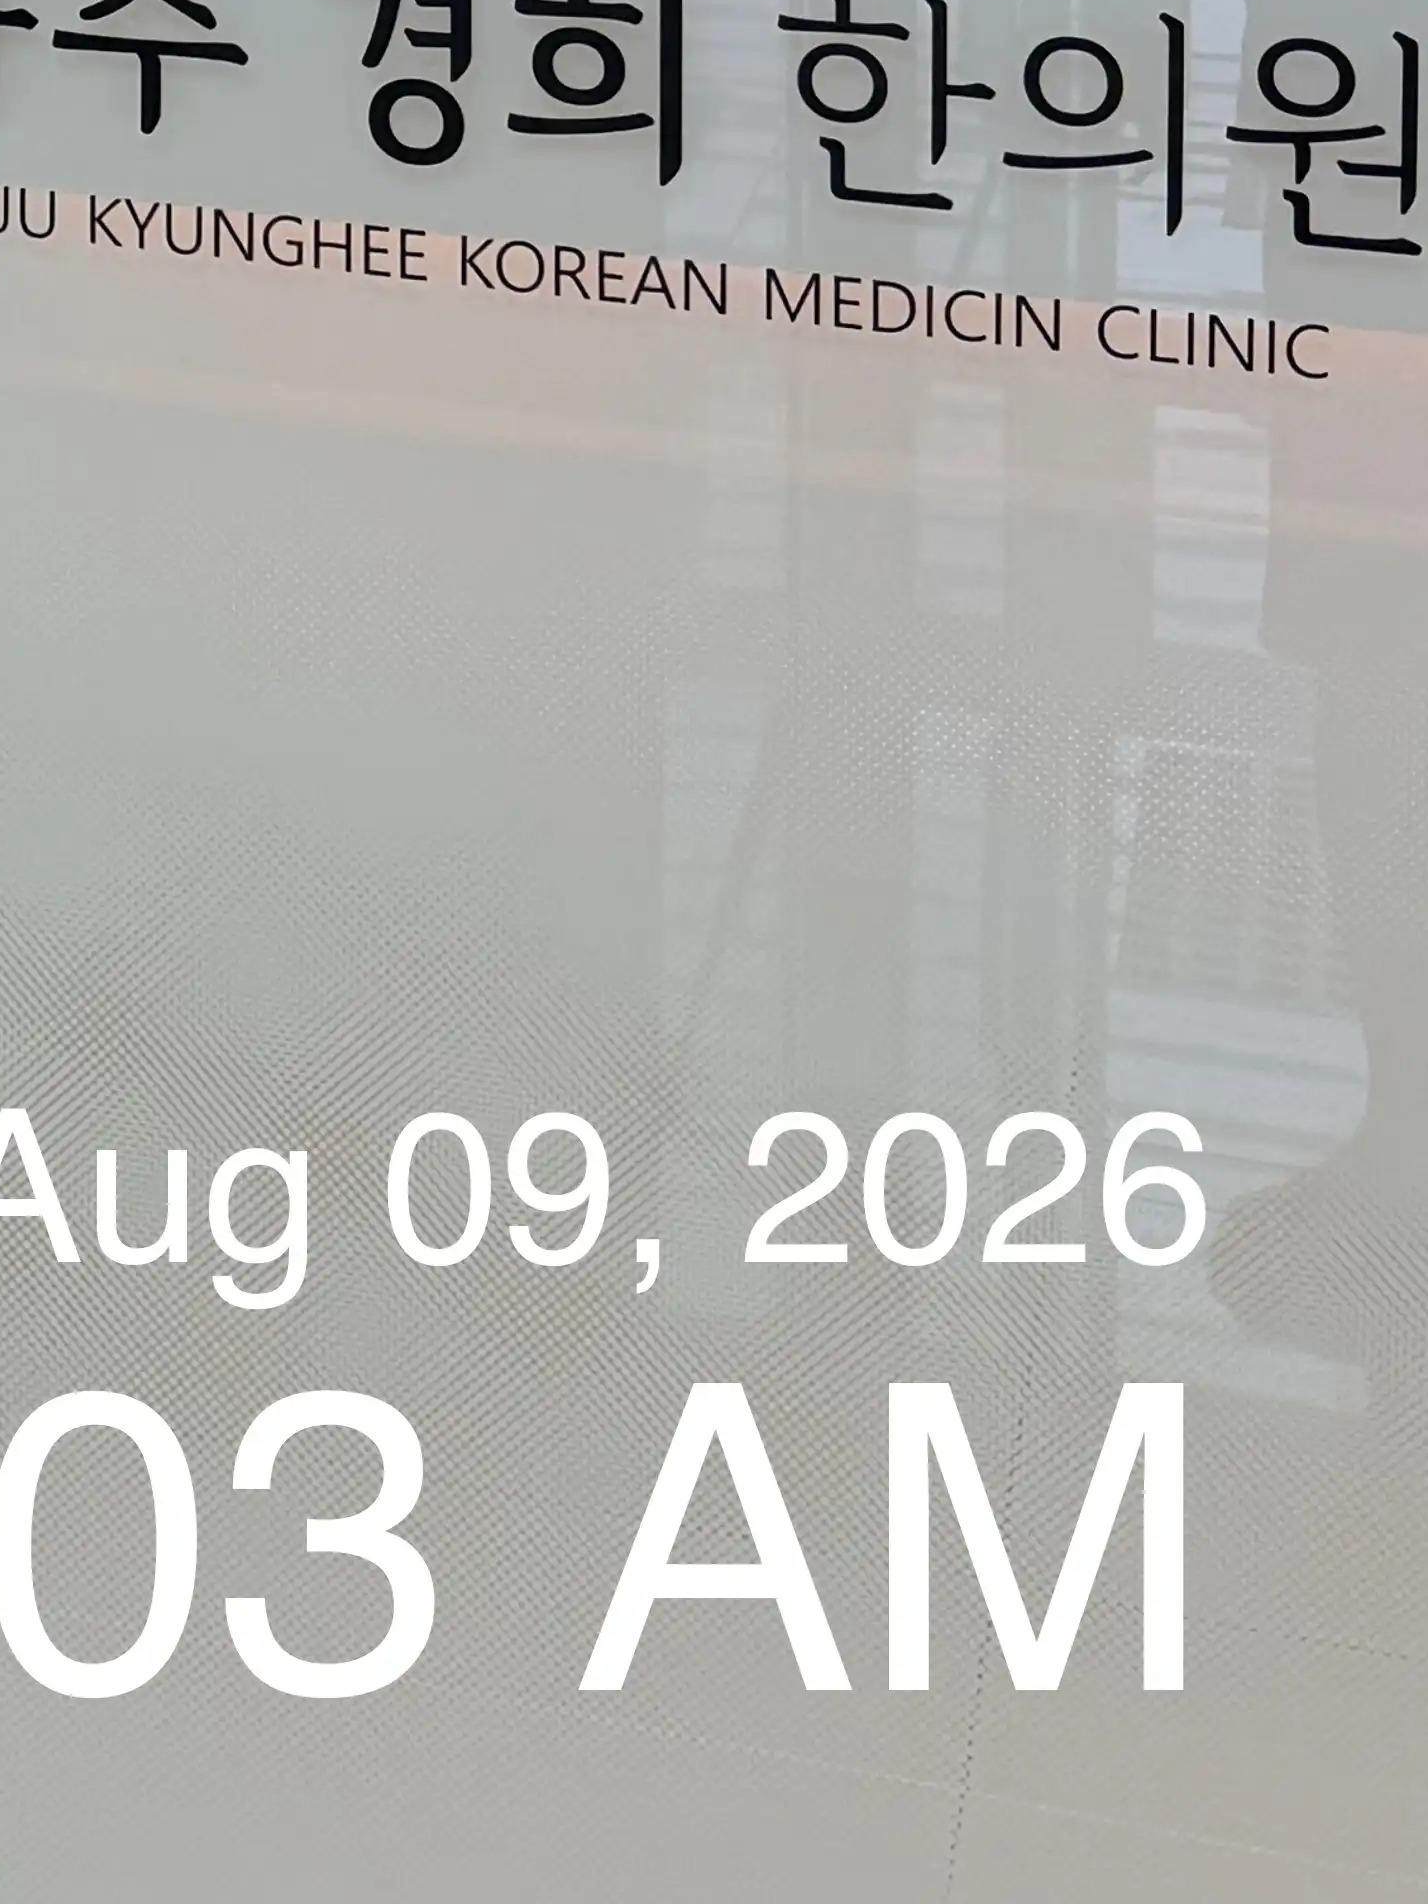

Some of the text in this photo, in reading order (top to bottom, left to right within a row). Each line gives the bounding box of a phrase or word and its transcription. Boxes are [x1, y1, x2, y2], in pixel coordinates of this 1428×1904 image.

[89, 194, 428, 282] KYUNGHEE
[461, 235, 727, 315] KOREAN
[765, 268, 1061, 352] MEDICIN
[1097, 305, 1330, 380] CLINIC
